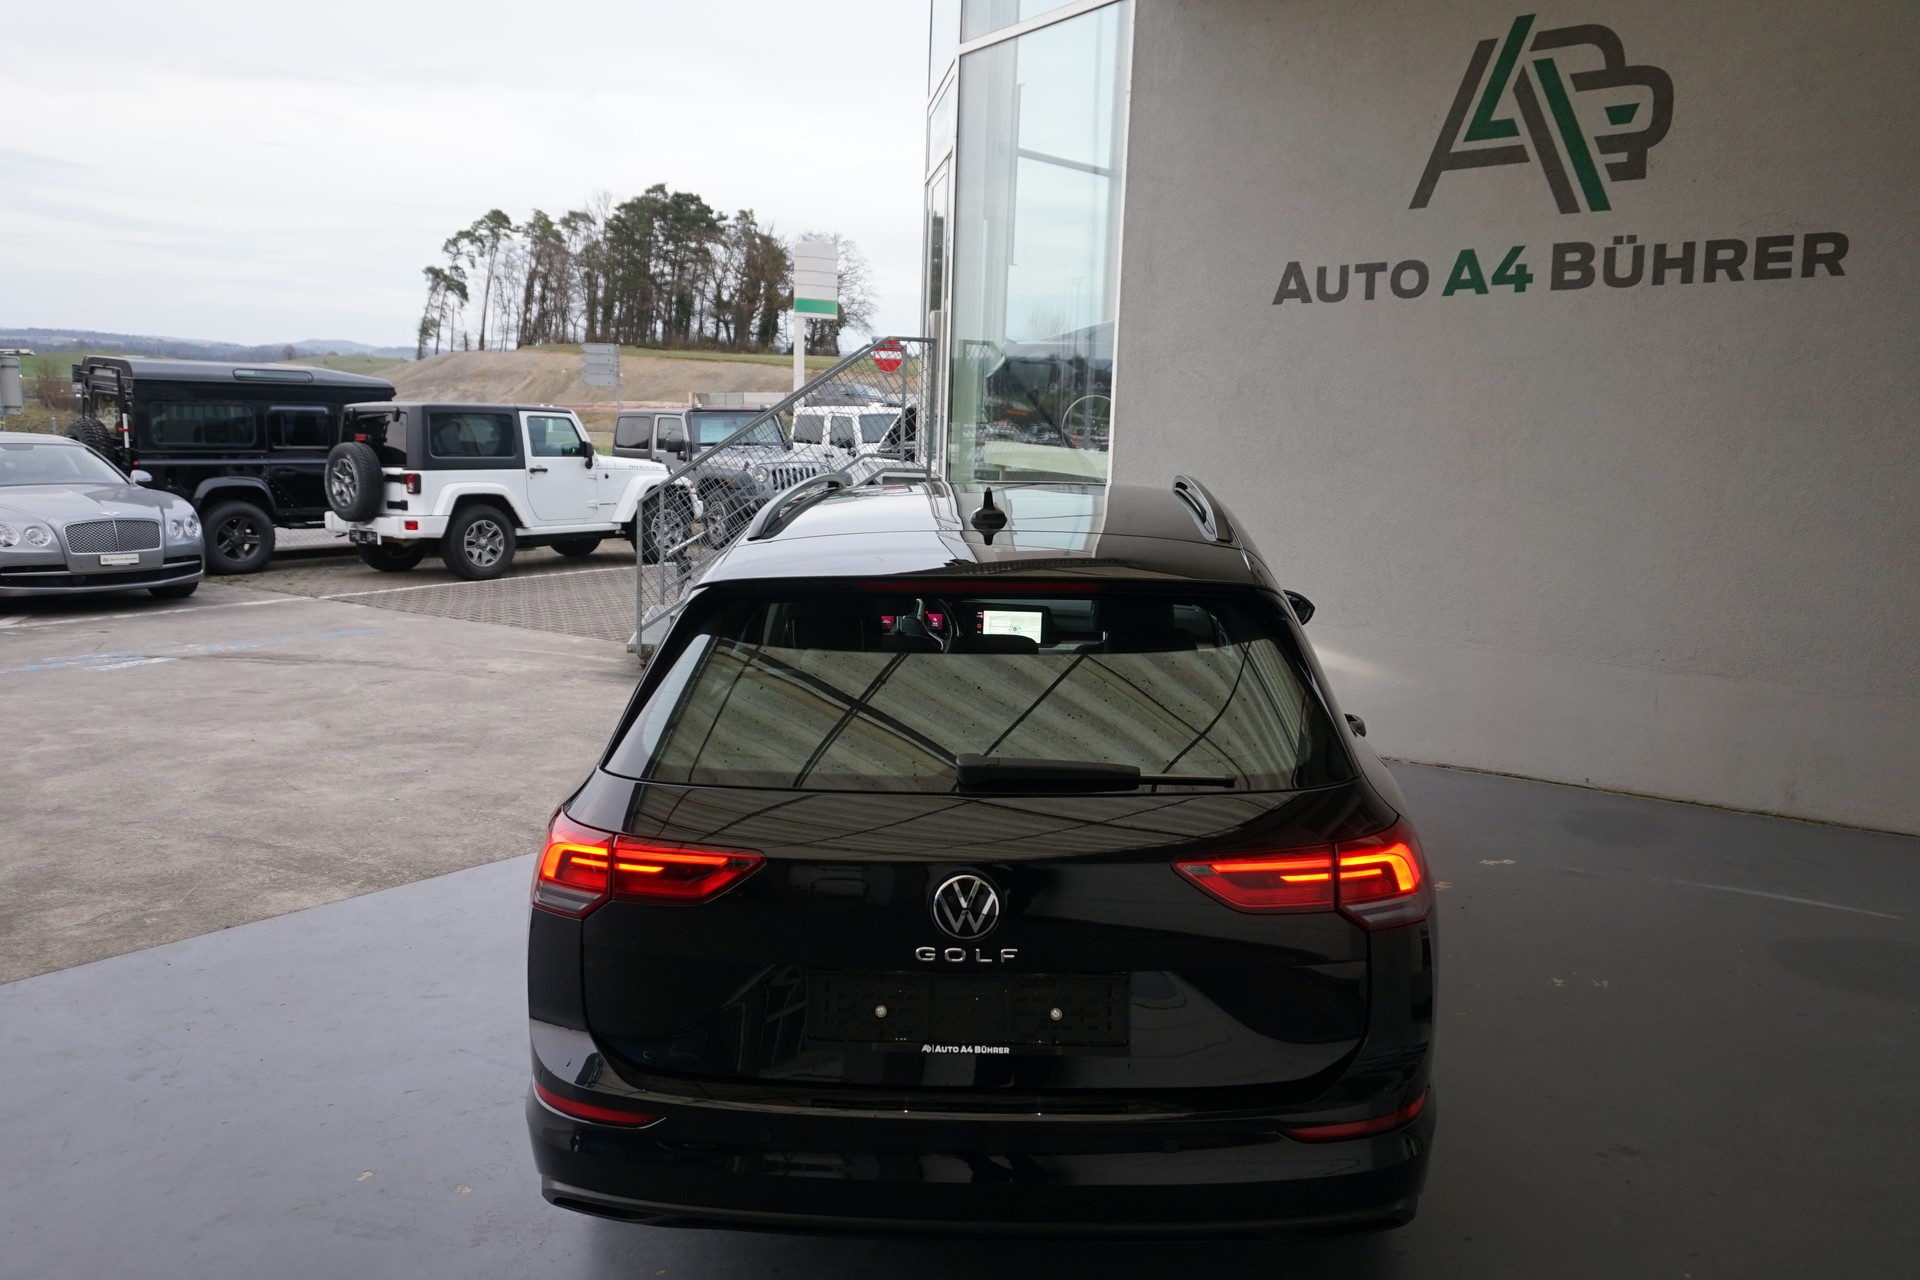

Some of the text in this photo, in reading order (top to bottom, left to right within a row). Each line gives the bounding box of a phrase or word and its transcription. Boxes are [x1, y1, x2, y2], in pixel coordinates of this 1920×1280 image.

[1272, 232, 1850, 305] AUTO A4 BÜHRER
[915, 946, 1018, 963] GOLF
[934, 1044, 960, 1054] AUTO
[960, 1045, 973, 1054] A4
[974, 1045, 1010, 1054] BÜHRER
